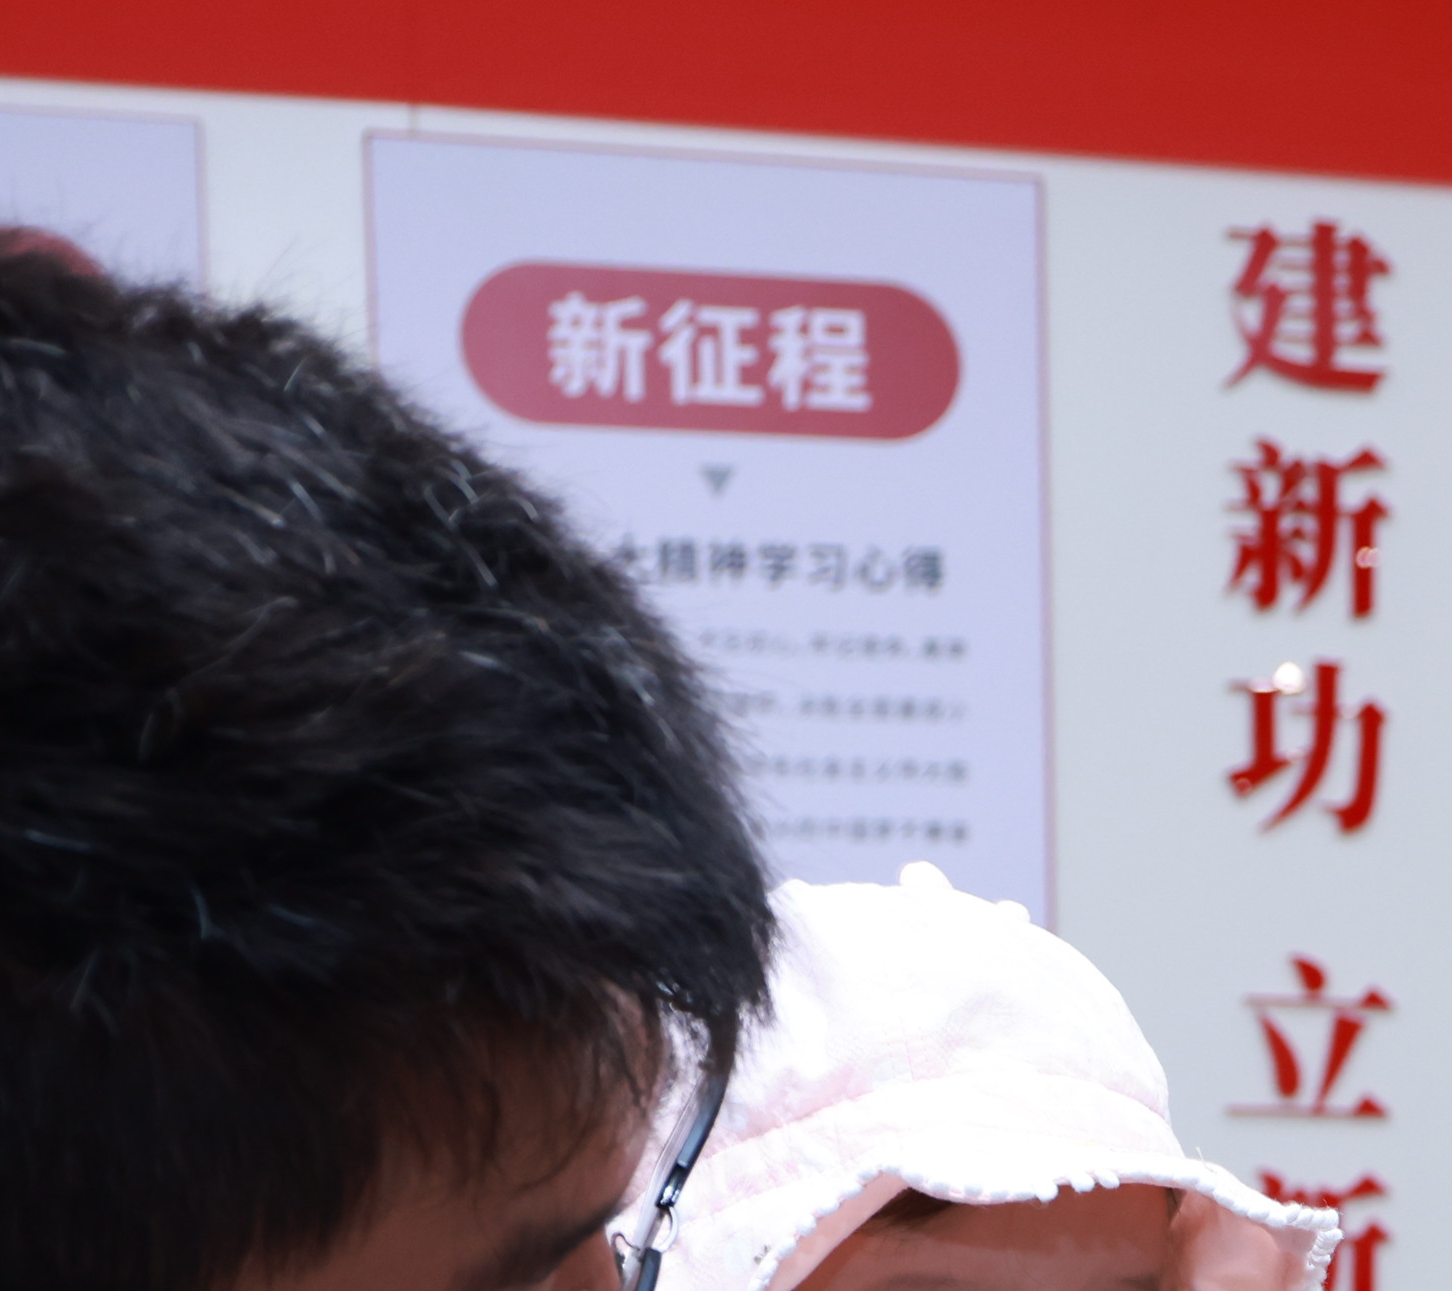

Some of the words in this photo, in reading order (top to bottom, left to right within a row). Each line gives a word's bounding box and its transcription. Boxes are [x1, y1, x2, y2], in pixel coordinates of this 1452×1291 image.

[547, 291, 874, 412] 新征程
[1223, 220, 1393, 836] 建新功
